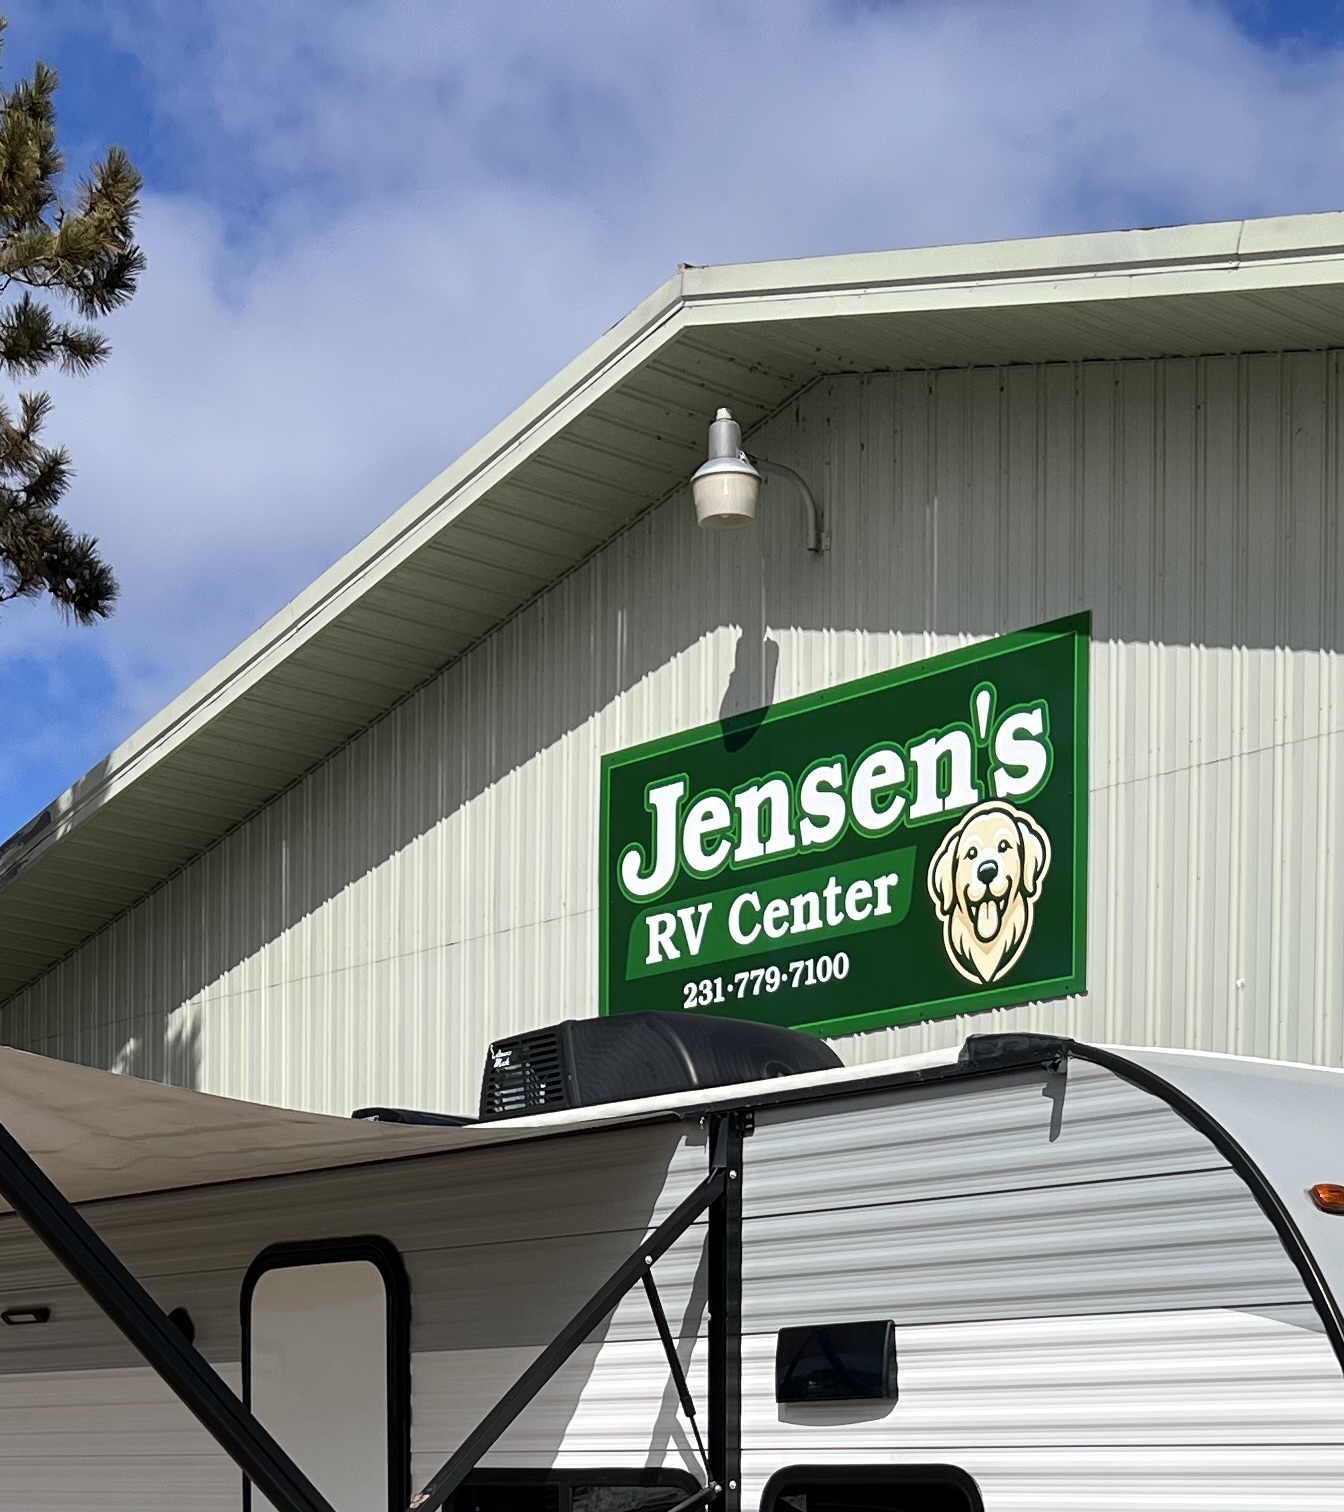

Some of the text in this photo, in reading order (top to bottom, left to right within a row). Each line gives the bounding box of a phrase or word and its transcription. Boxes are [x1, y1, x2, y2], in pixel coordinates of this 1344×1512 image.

[621, 689, 1049, 896] Jensen's
[645, 865, 899, 965] RV Center
